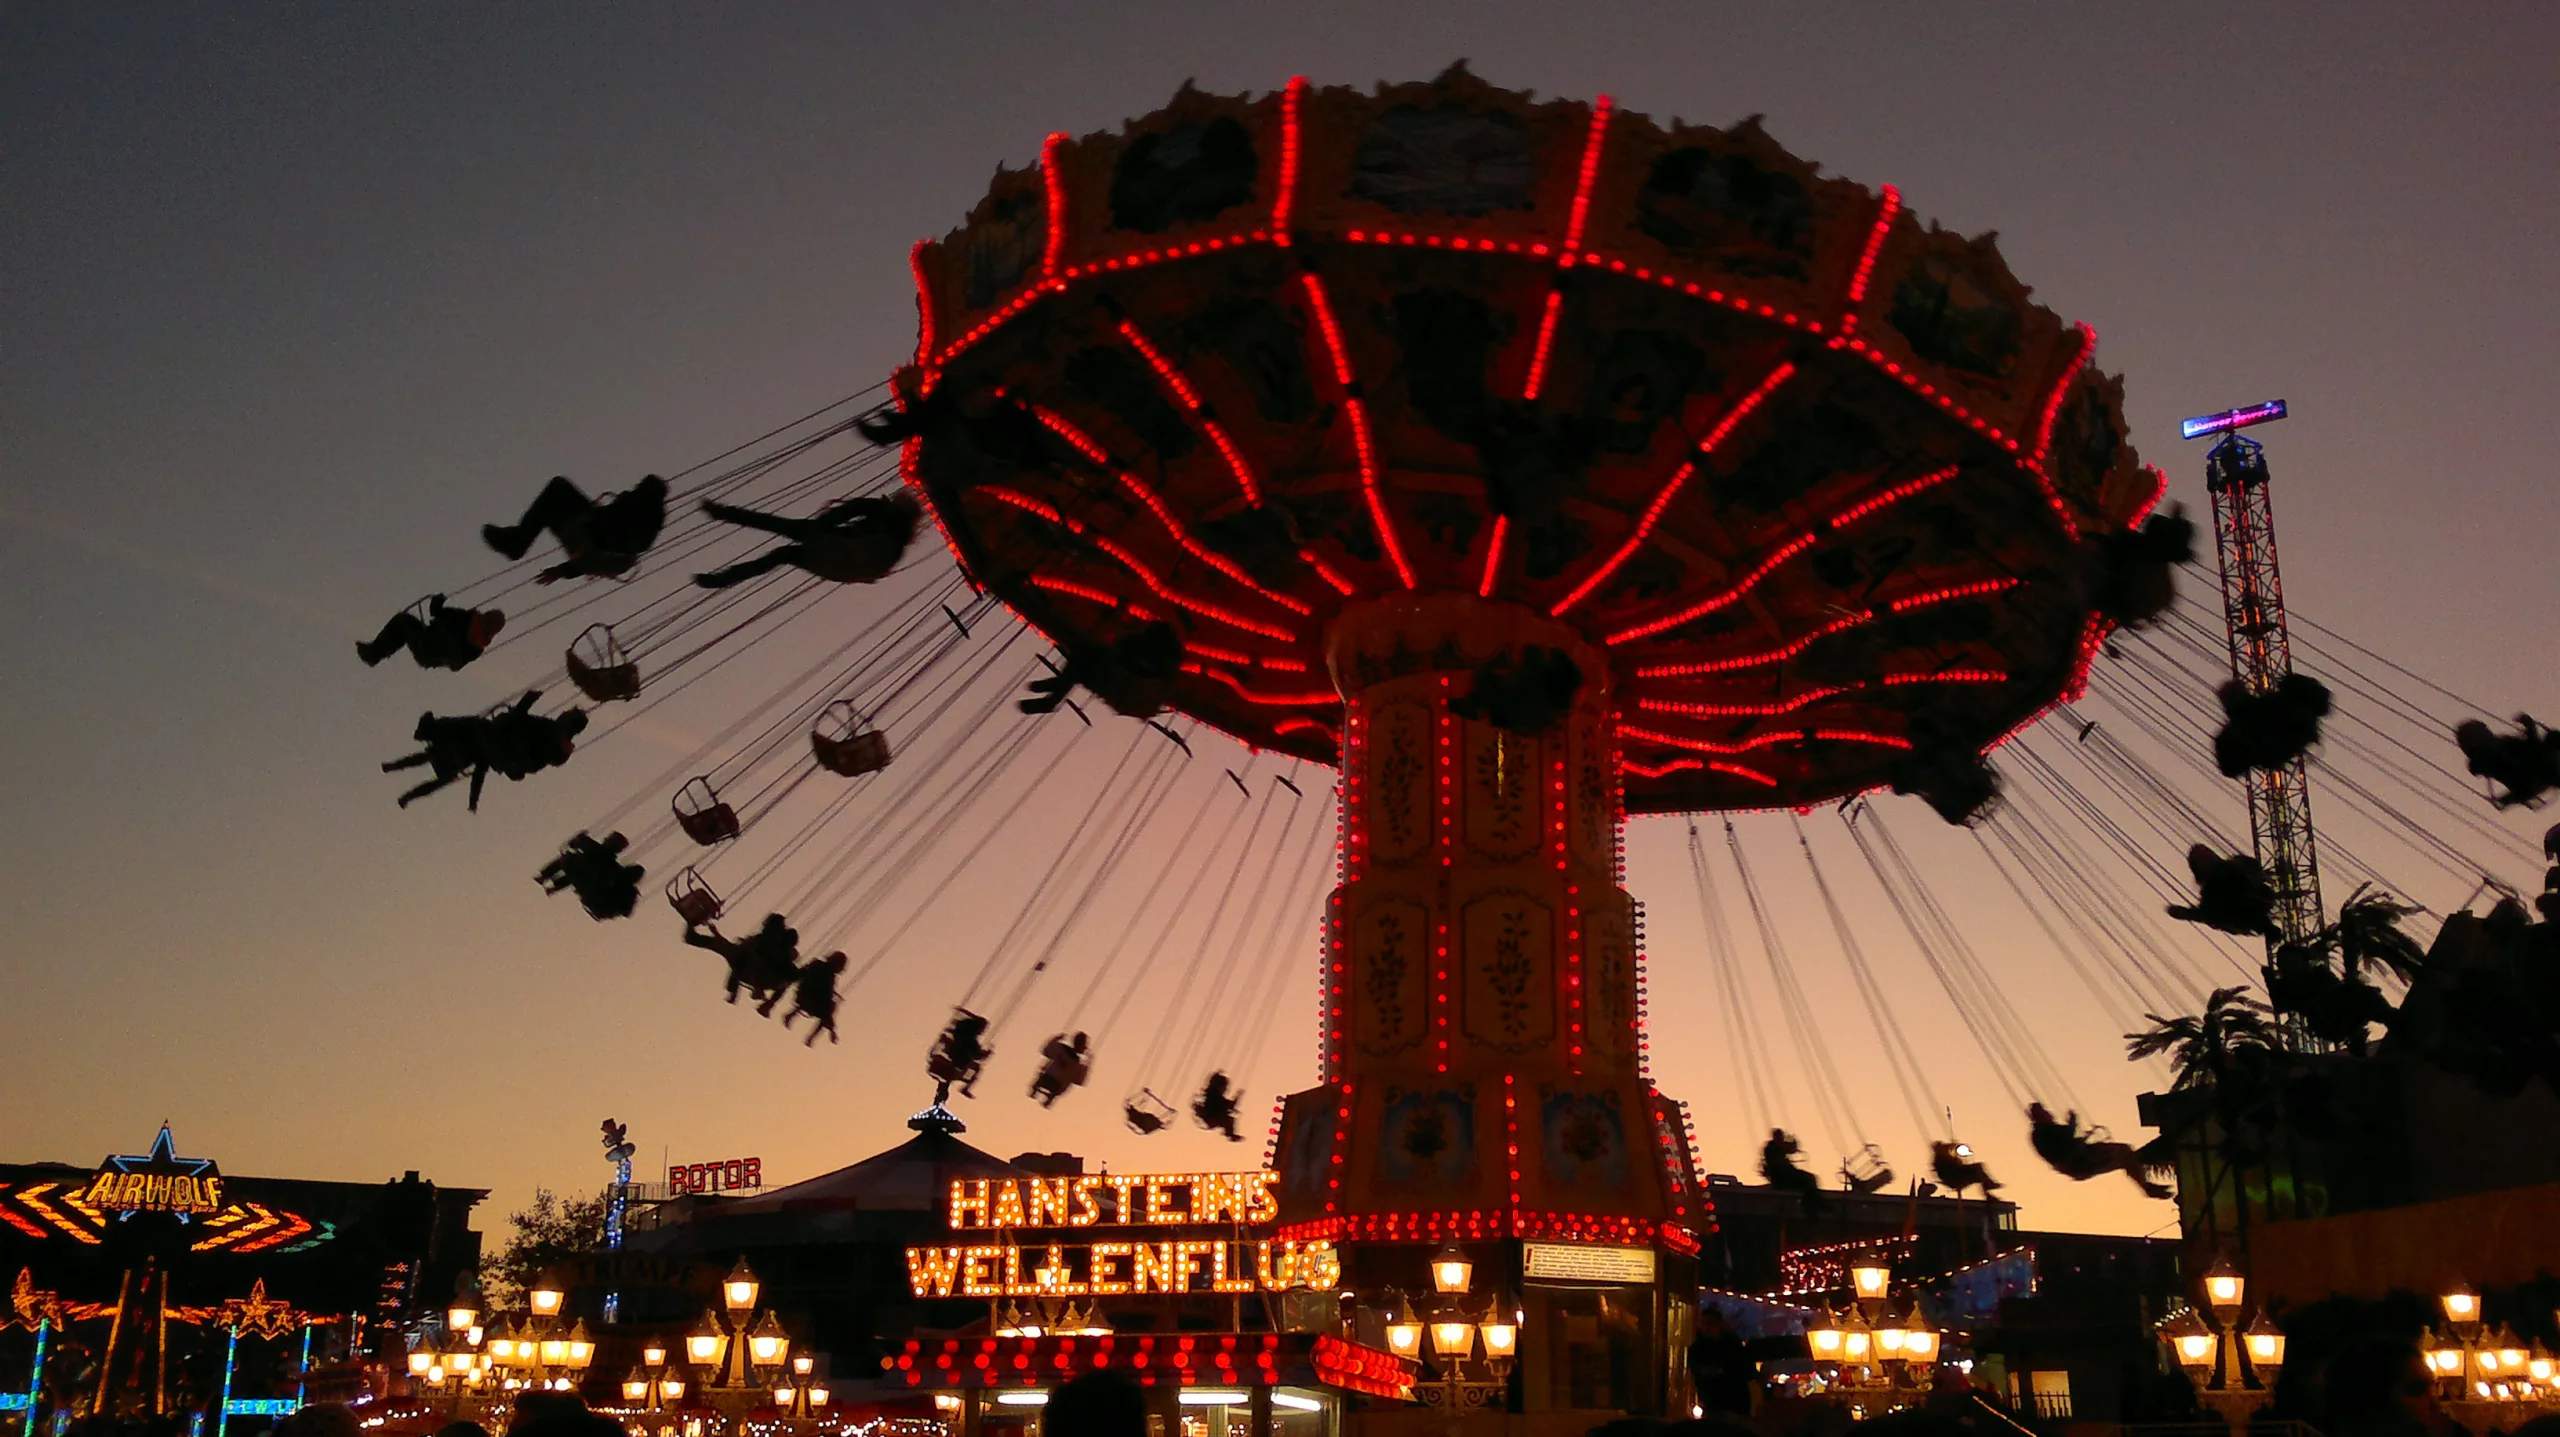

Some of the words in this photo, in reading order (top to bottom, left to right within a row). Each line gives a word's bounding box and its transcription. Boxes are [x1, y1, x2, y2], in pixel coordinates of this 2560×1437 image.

[86, 1171, 222, 1207] AIRWOLF
[669, 1157, 761, 1196] ROTOR
[949, 1171, 1280, 1229] HANSTEINS
[906, 1239, 1341, 1298] WELLENFLUG
